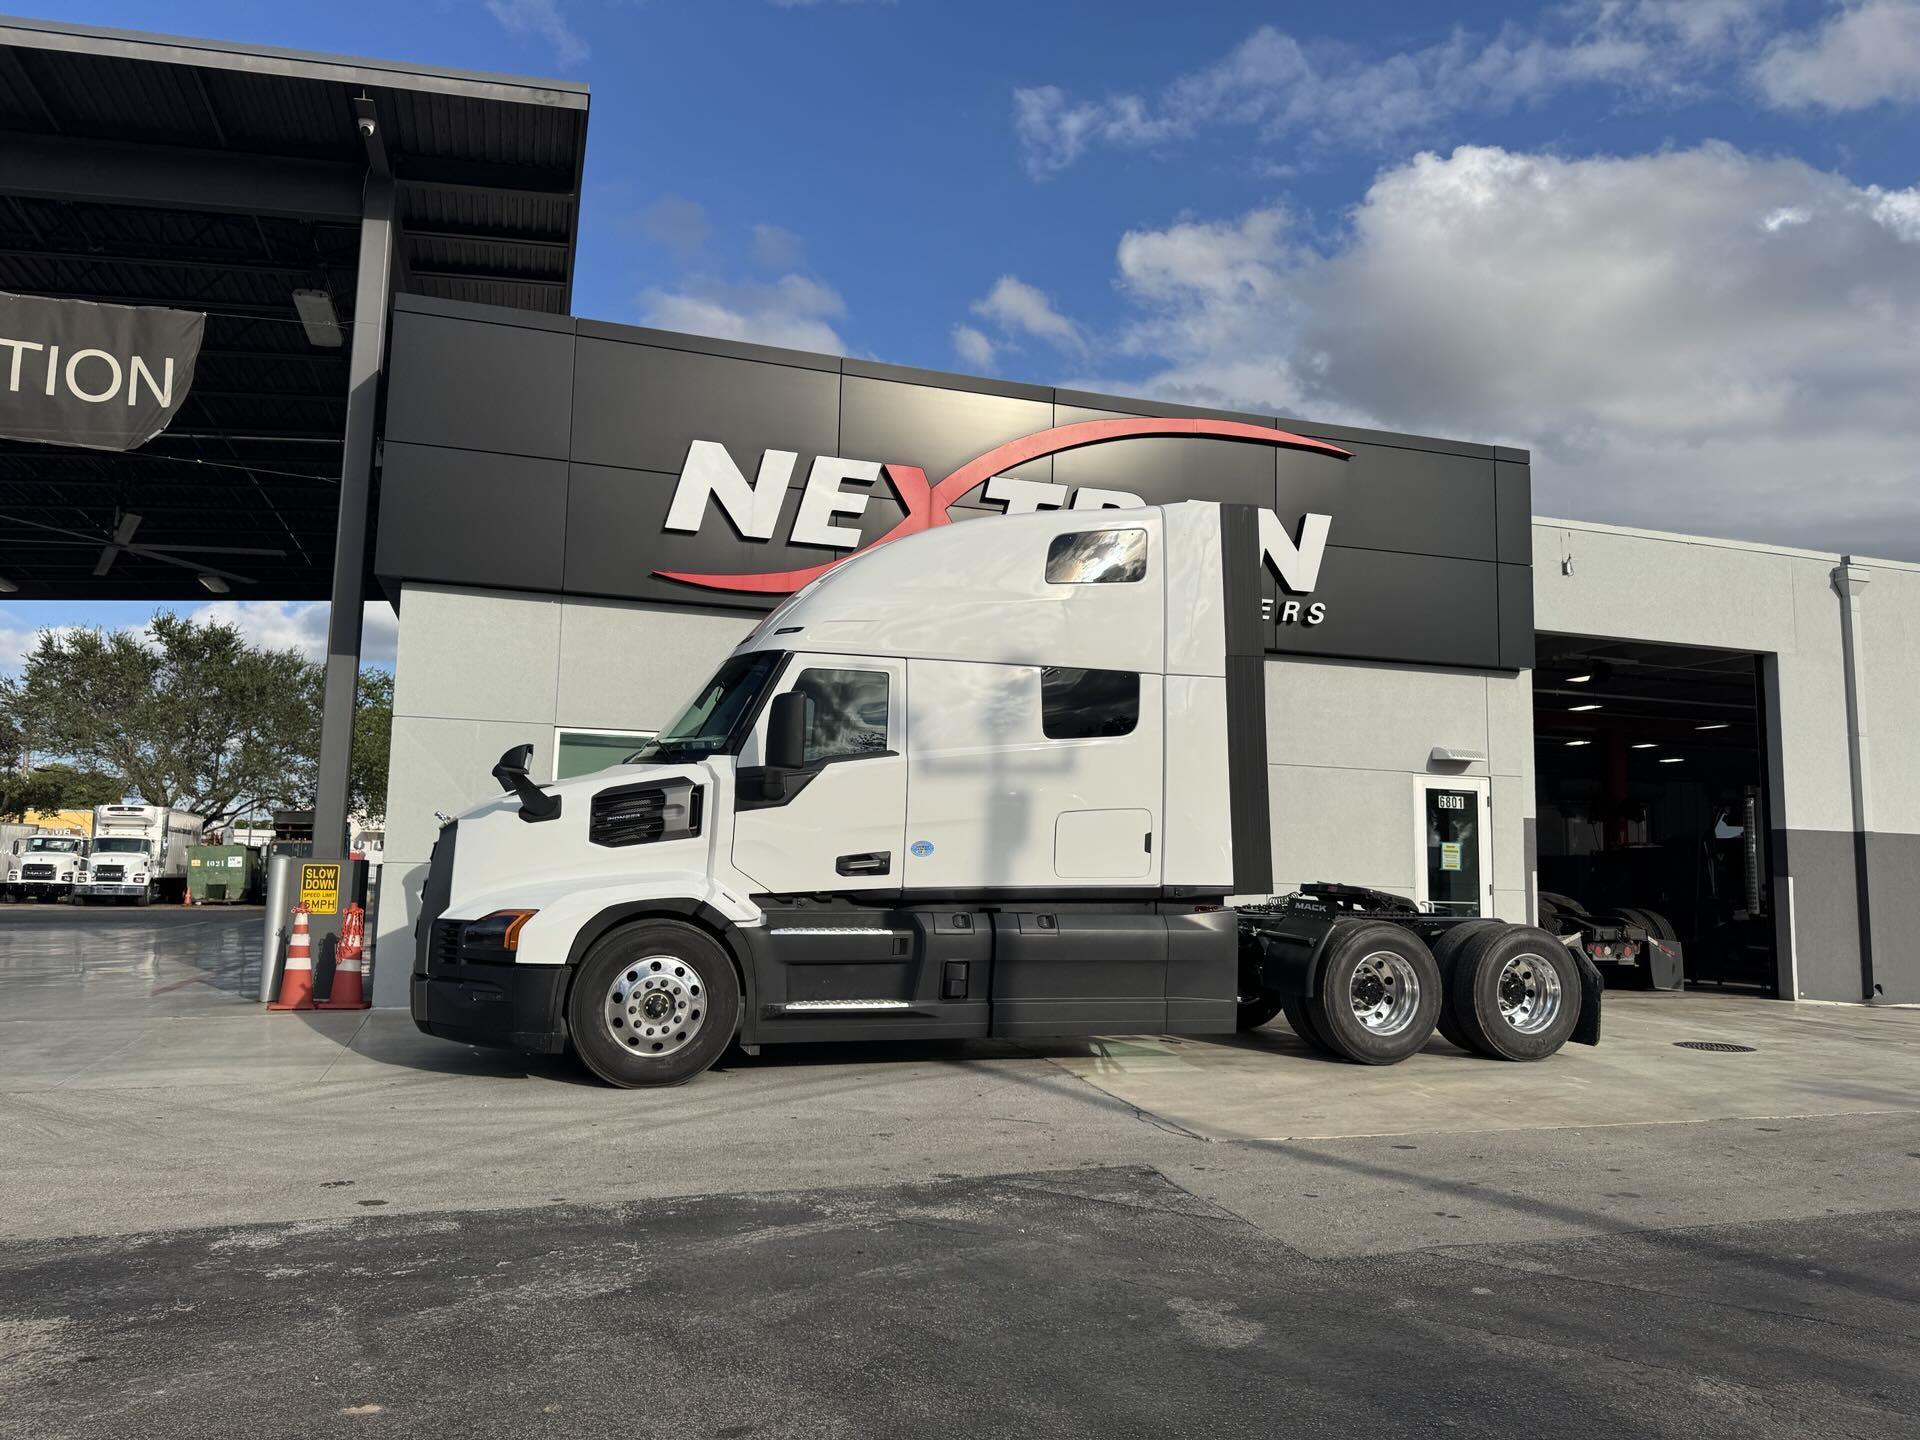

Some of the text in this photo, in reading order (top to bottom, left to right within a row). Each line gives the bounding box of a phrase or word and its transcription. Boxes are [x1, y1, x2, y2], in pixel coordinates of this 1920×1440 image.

[0, 337, 174, 408] TION
[1439, 796, 1463, 809] 6801
[305, 868, 336, 879] SLOW
[305, 879, 335, 890] DOWN
[1294, 902, 1328, 913] MACK
